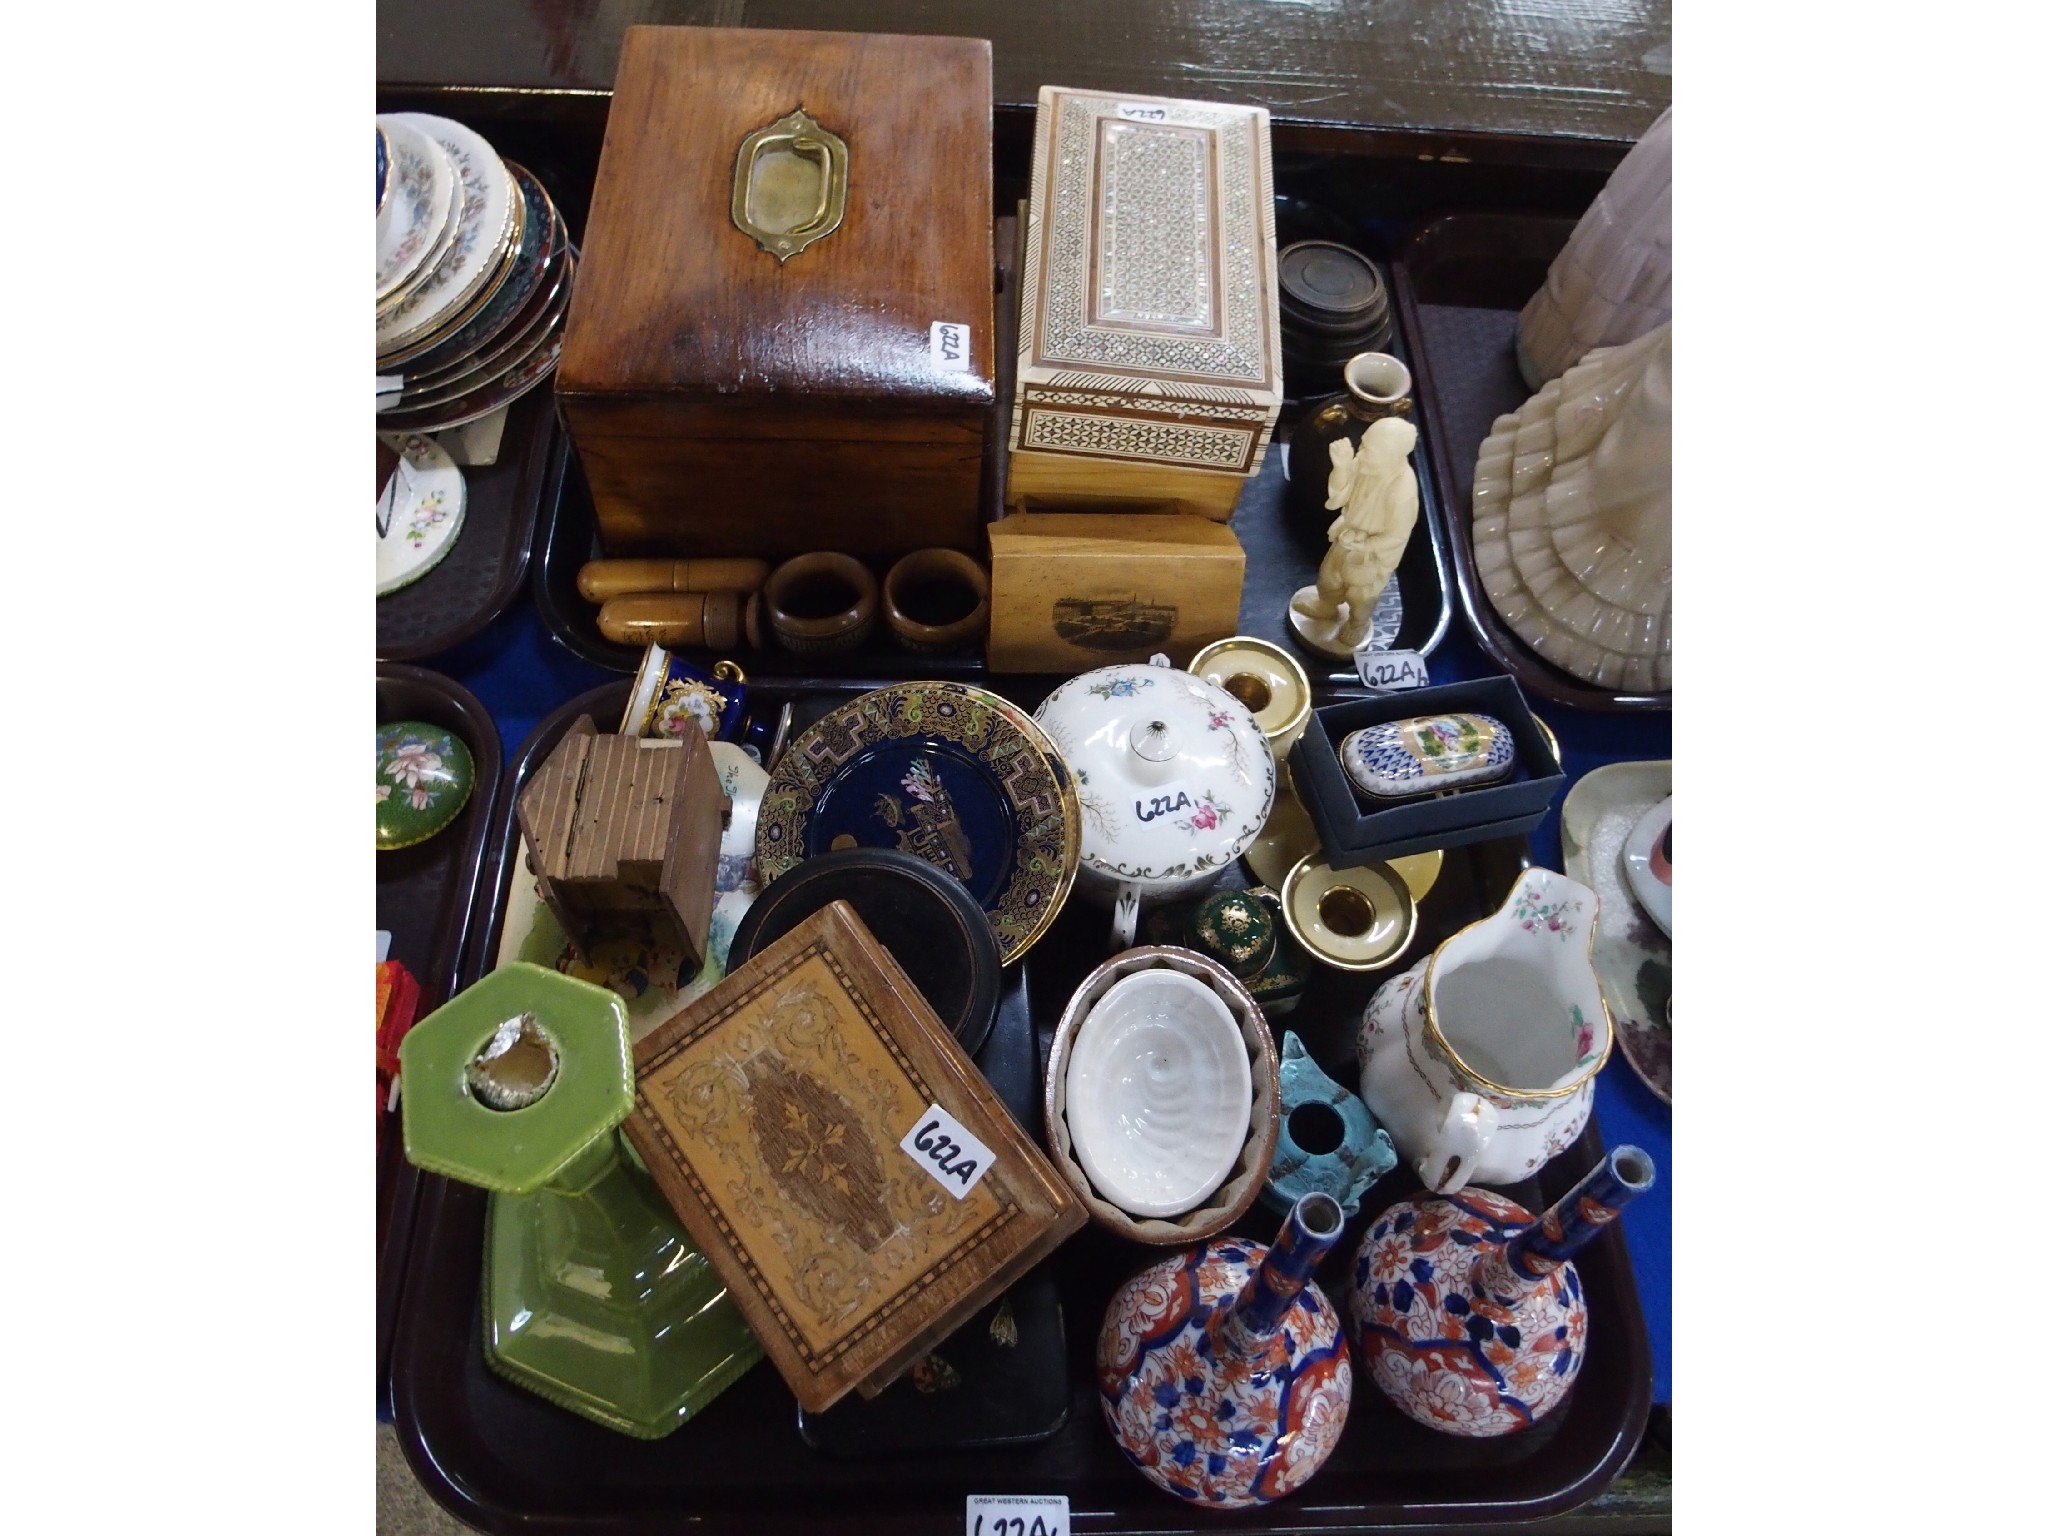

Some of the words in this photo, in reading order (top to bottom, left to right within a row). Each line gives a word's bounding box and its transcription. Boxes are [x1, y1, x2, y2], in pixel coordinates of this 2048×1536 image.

[1122, 108, 1165, 120] 622A
[939, 324, 960, 360] 622A
[1135, 791, 1191, 822] 622A
[914, 1120, 977, 1185] 622A
[974, 1497, 995, 1505] GREAT
[997, 1497, 1028, 1505] WESTERN
[1030, 1497, 1062, 1505] AUCTIONS
